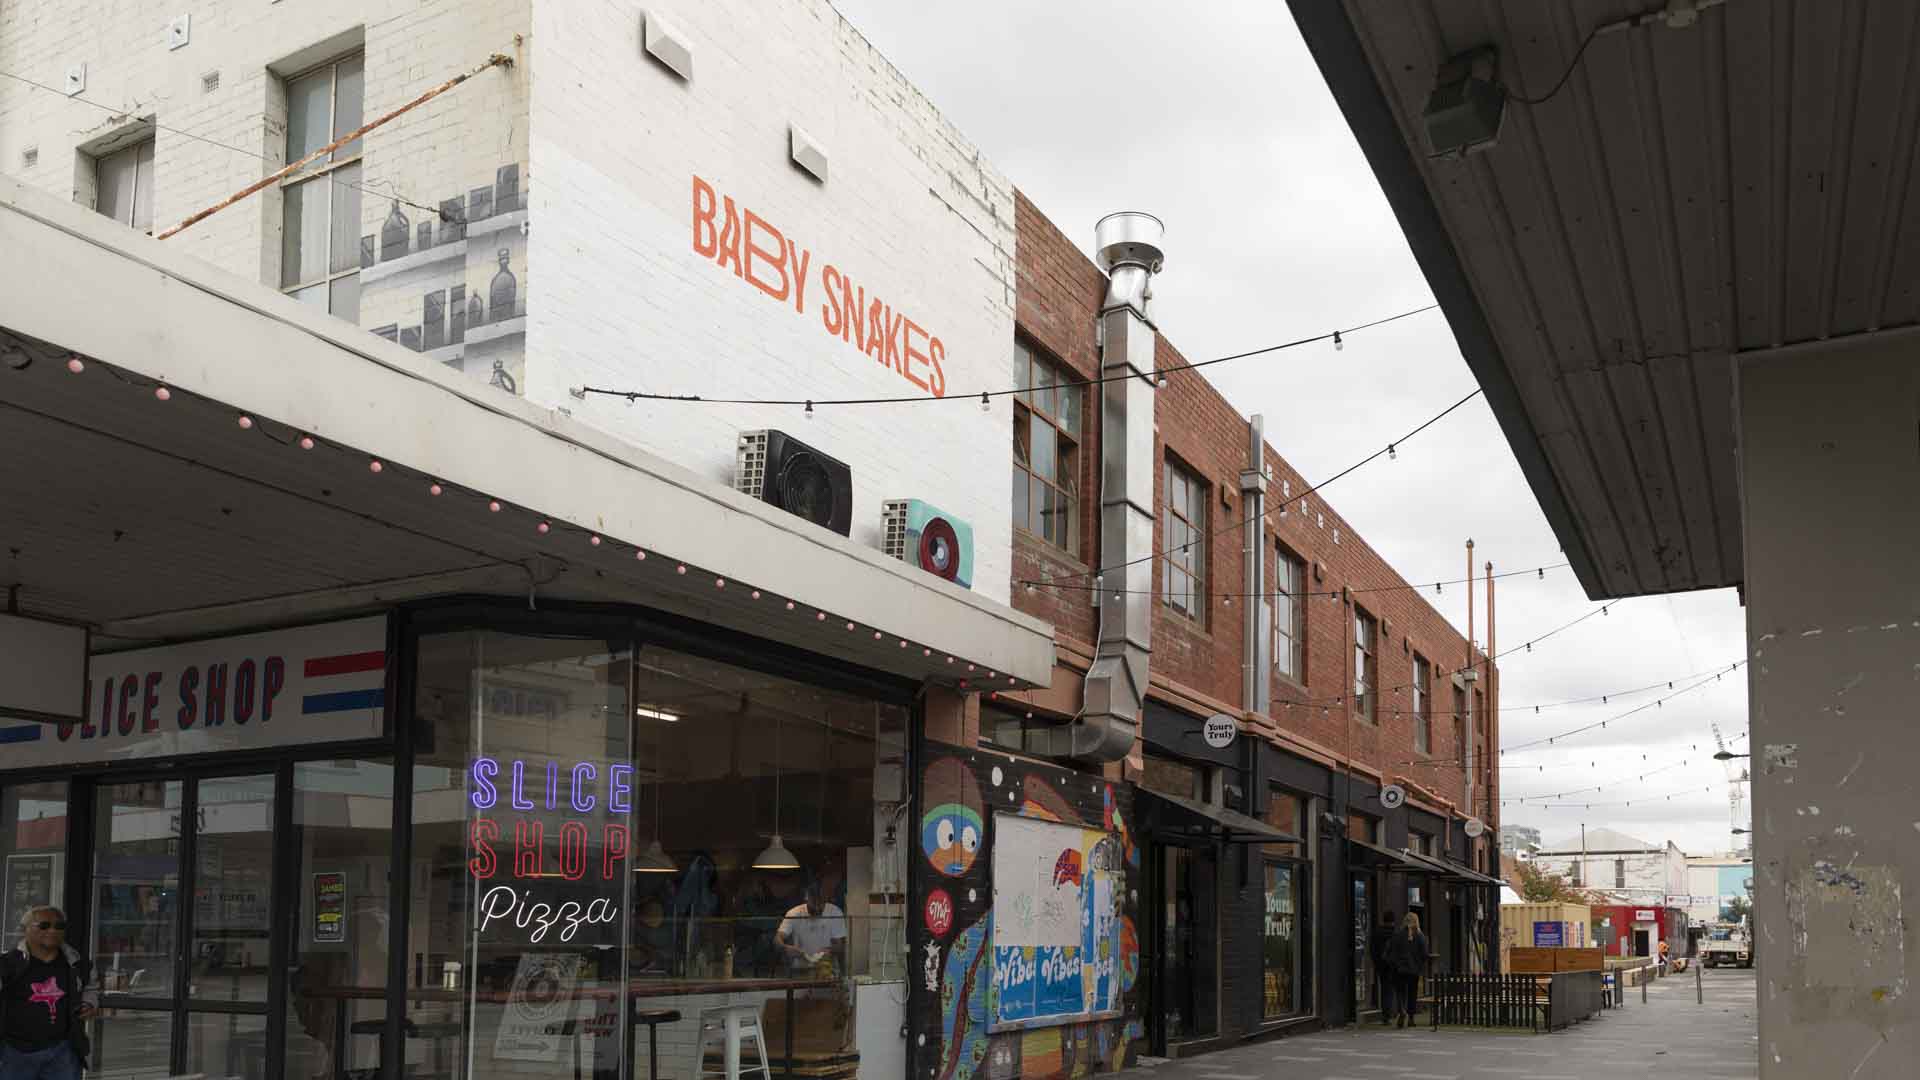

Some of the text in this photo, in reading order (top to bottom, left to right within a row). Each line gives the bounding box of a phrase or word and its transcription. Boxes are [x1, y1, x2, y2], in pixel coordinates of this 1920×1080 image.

[693, 174, 946, 399] BABY SNAKES
[57, 655, 285, 742] LICE SHOP
[1207, 723, 1233, 731] Yours
[1207, 731, 1233, 739] Truly
[471, 757, 634, 812] SLICE
[468, 818, 632, 881] SHOP
[480, 885, 617, 944] Pizza
[1041, 947, 1080, 986] Vibes
